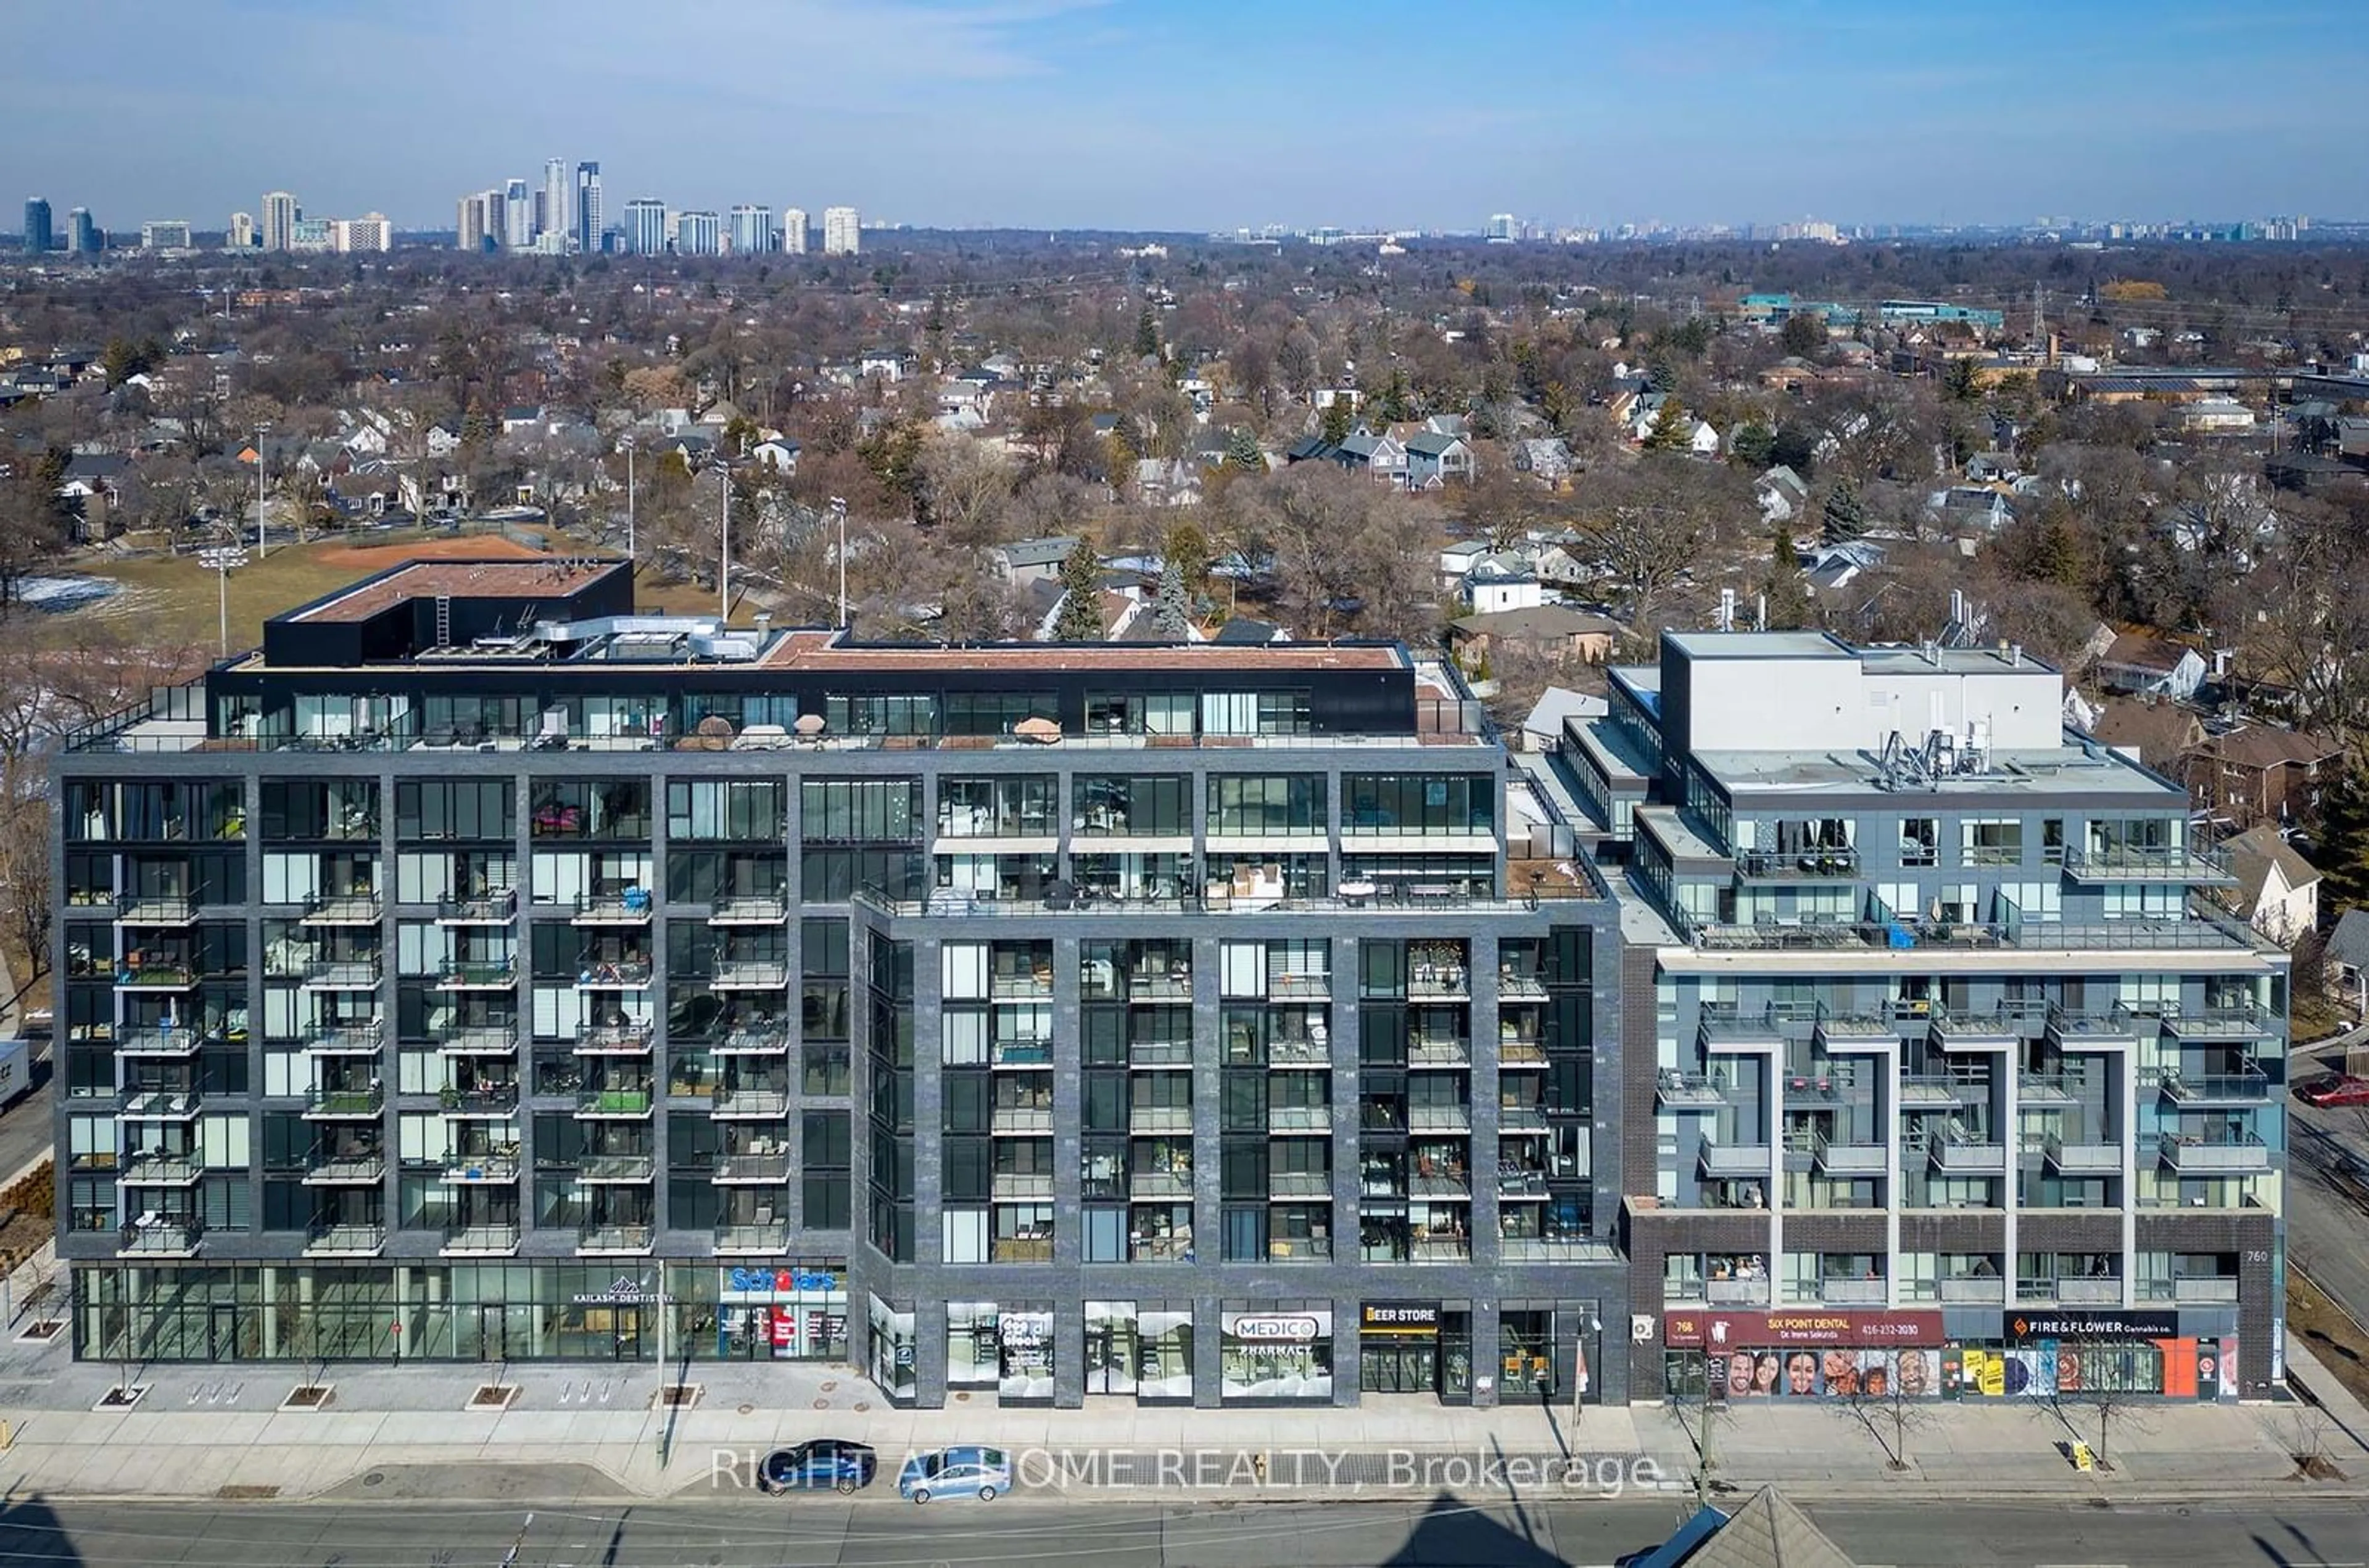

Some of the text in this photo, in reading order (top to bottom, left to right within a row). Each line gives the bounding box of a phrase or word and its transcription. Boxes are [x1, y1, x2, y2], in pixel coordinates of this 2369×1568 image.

[2247, 1250, 2268, 1262] 760
[732, 1268, 836, 1292] Scholars
[574, 1295, 614, 1303] KAILASH
[1366, 1307, 1436, 1321] BEER STORE
[1240, 1321, 1313, 1335] MEDICO
[1768, 1319, 1850, 1329] SIX POINT DENTAL
[1240, 1345, 1312, 1356] PHARMACY
